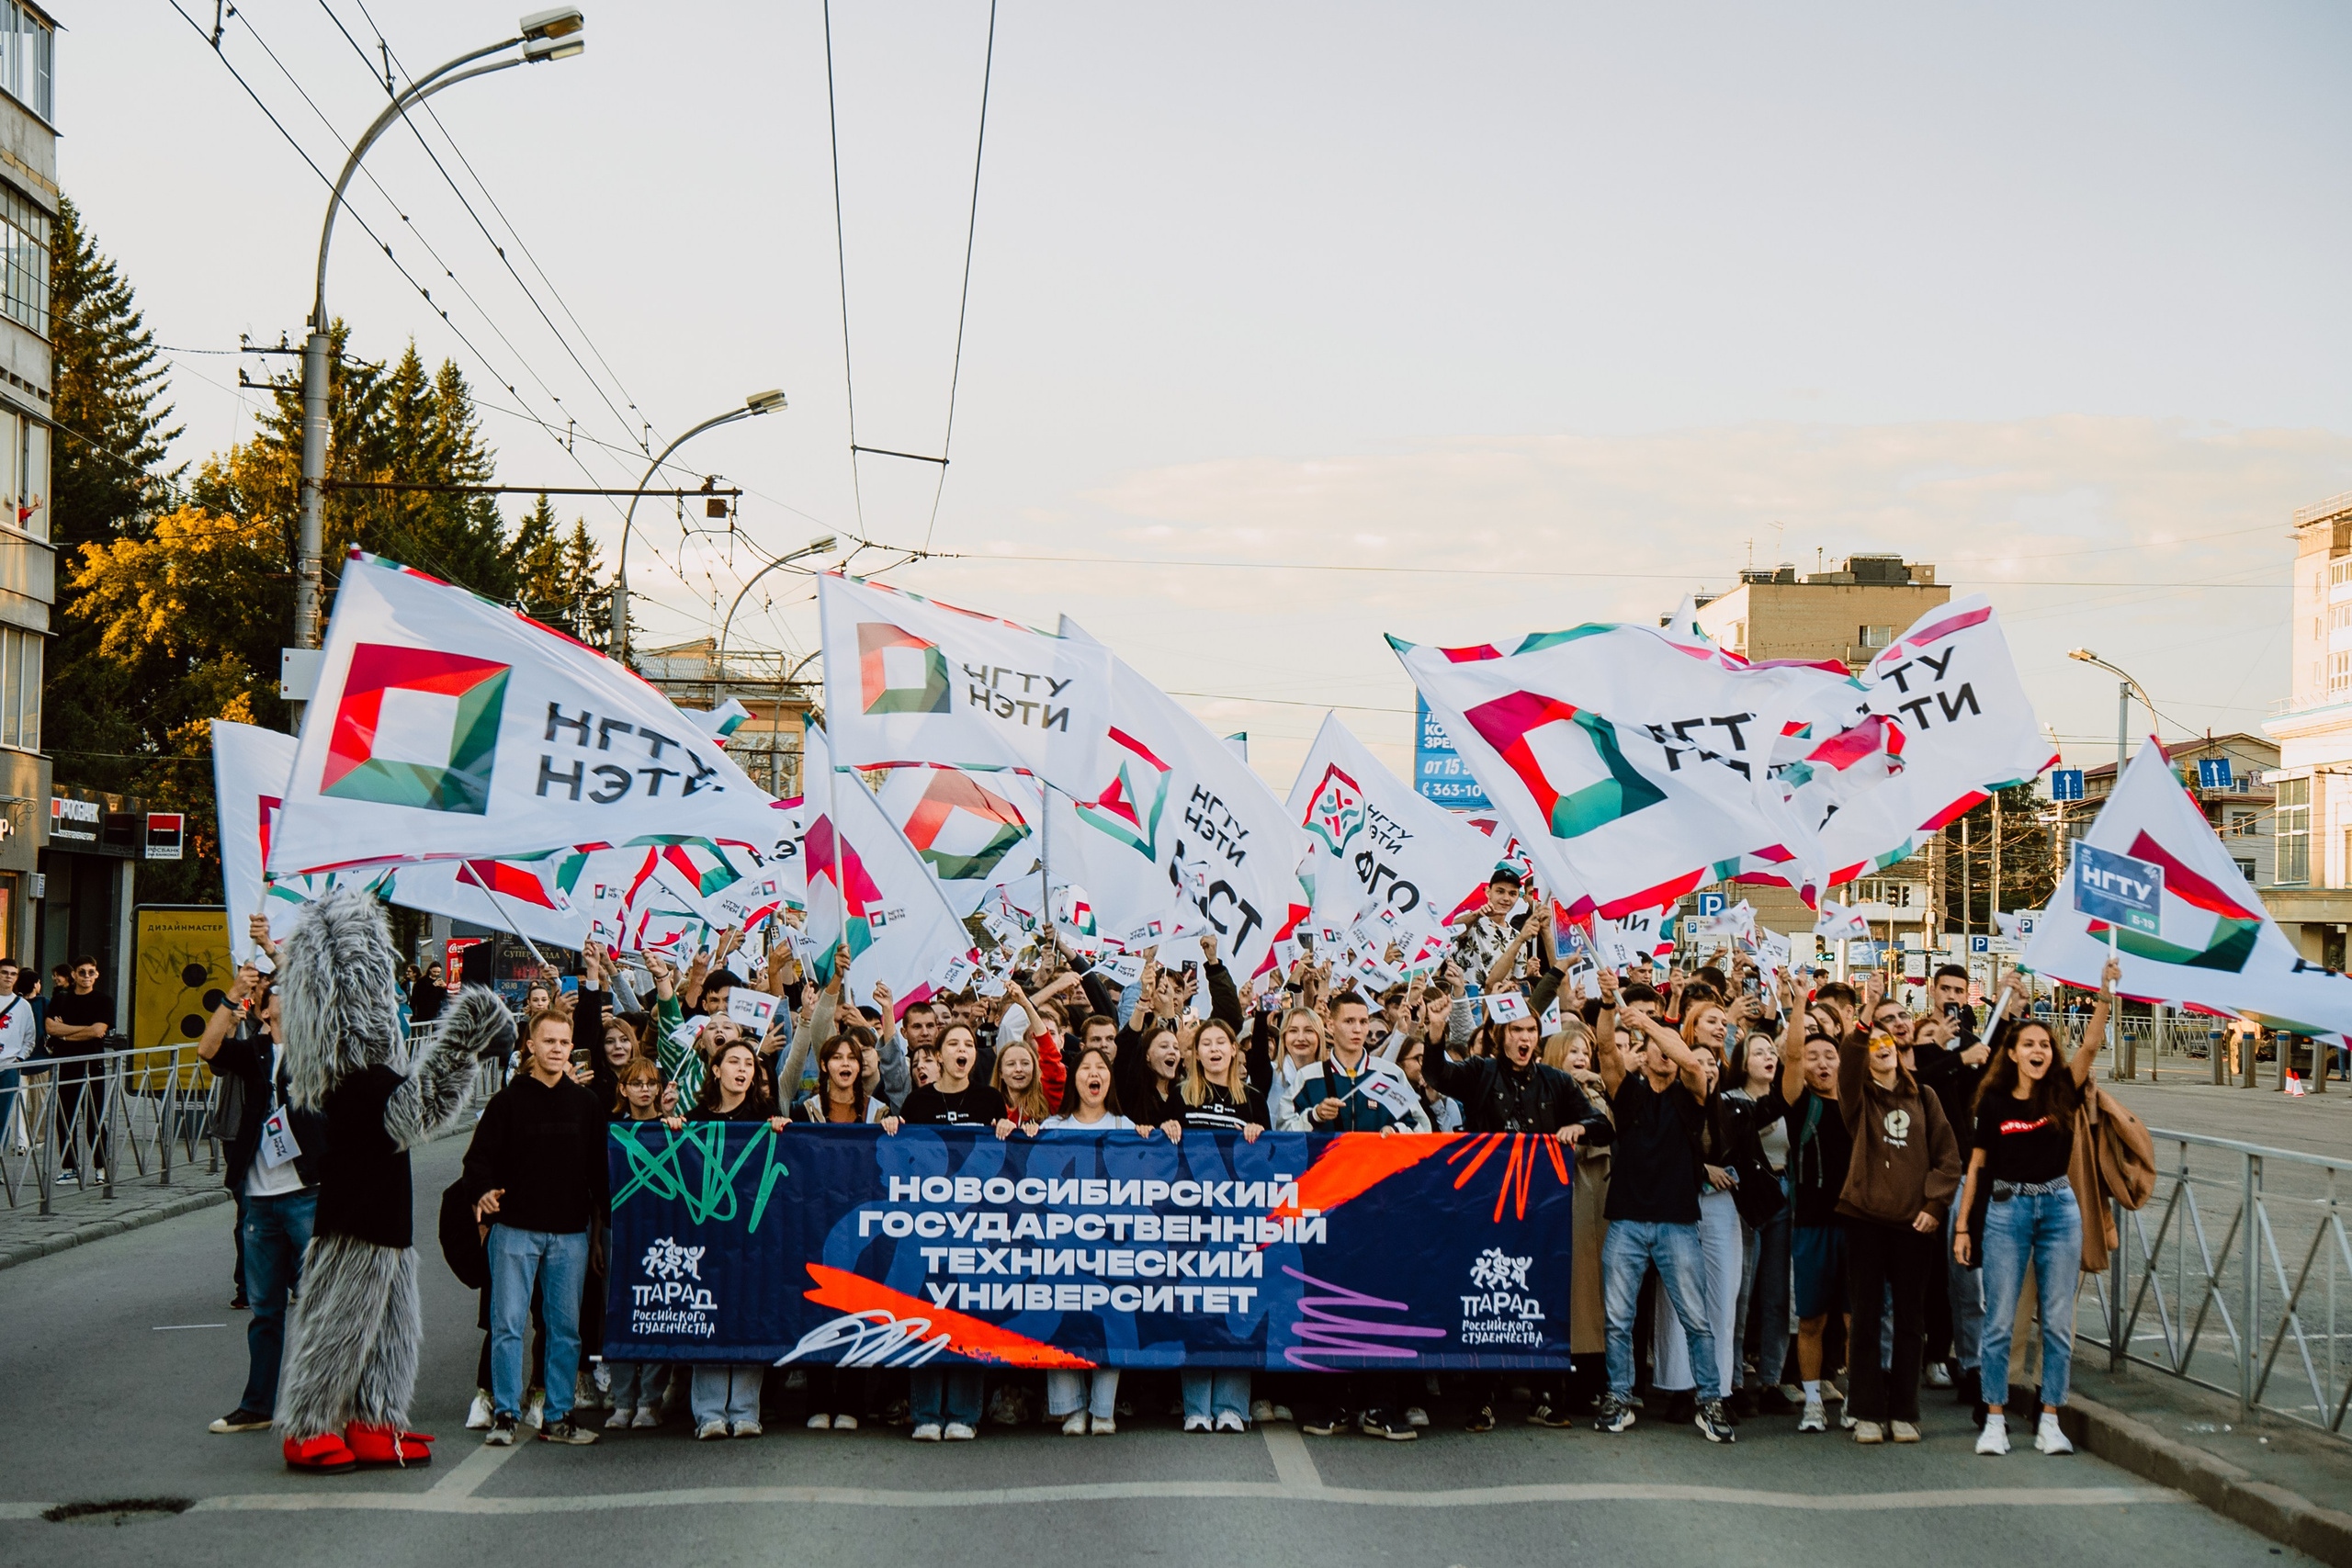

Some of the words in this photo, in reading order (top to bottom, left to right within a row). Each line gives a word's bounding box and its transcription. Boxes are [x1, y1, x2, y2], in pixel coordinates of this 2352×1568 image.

[963, 662, 1073, 697] НГТУ
[969, 683, 1069, 732] НЭТИ
[61, 798, 100, 823] РОСБАНК
[1191, 784, 1250, 840] НГТУ
[1367, 804, 1414, 840] НГТУ
[1185, 807, 1247, 868] НЭТИ
[1369, 825, 1403, 855] ЭТИ
[2082, 863, 2153, 901] НГТУ
[147, 920, 223, 931] ДИЗАЙНМАСТЕР
[2132, 914, 2155, 931] Б-19
[889, 1174, 1299, 1209] НОВОСИБИРСКИЙ
[858, 1209, 1328, 1244] ГОСУДАРСТВЕННЫЙ
[921, 1244, 1263, 1278] ТЕХНИЧЕСКИЙ
[632, 1281, 718, 1310] ПАРАД
[925, 1282, 1258, 1314] УНИВЕРСИТЕТ
[1460, 1292, 1545, 1320] ПАРАД
